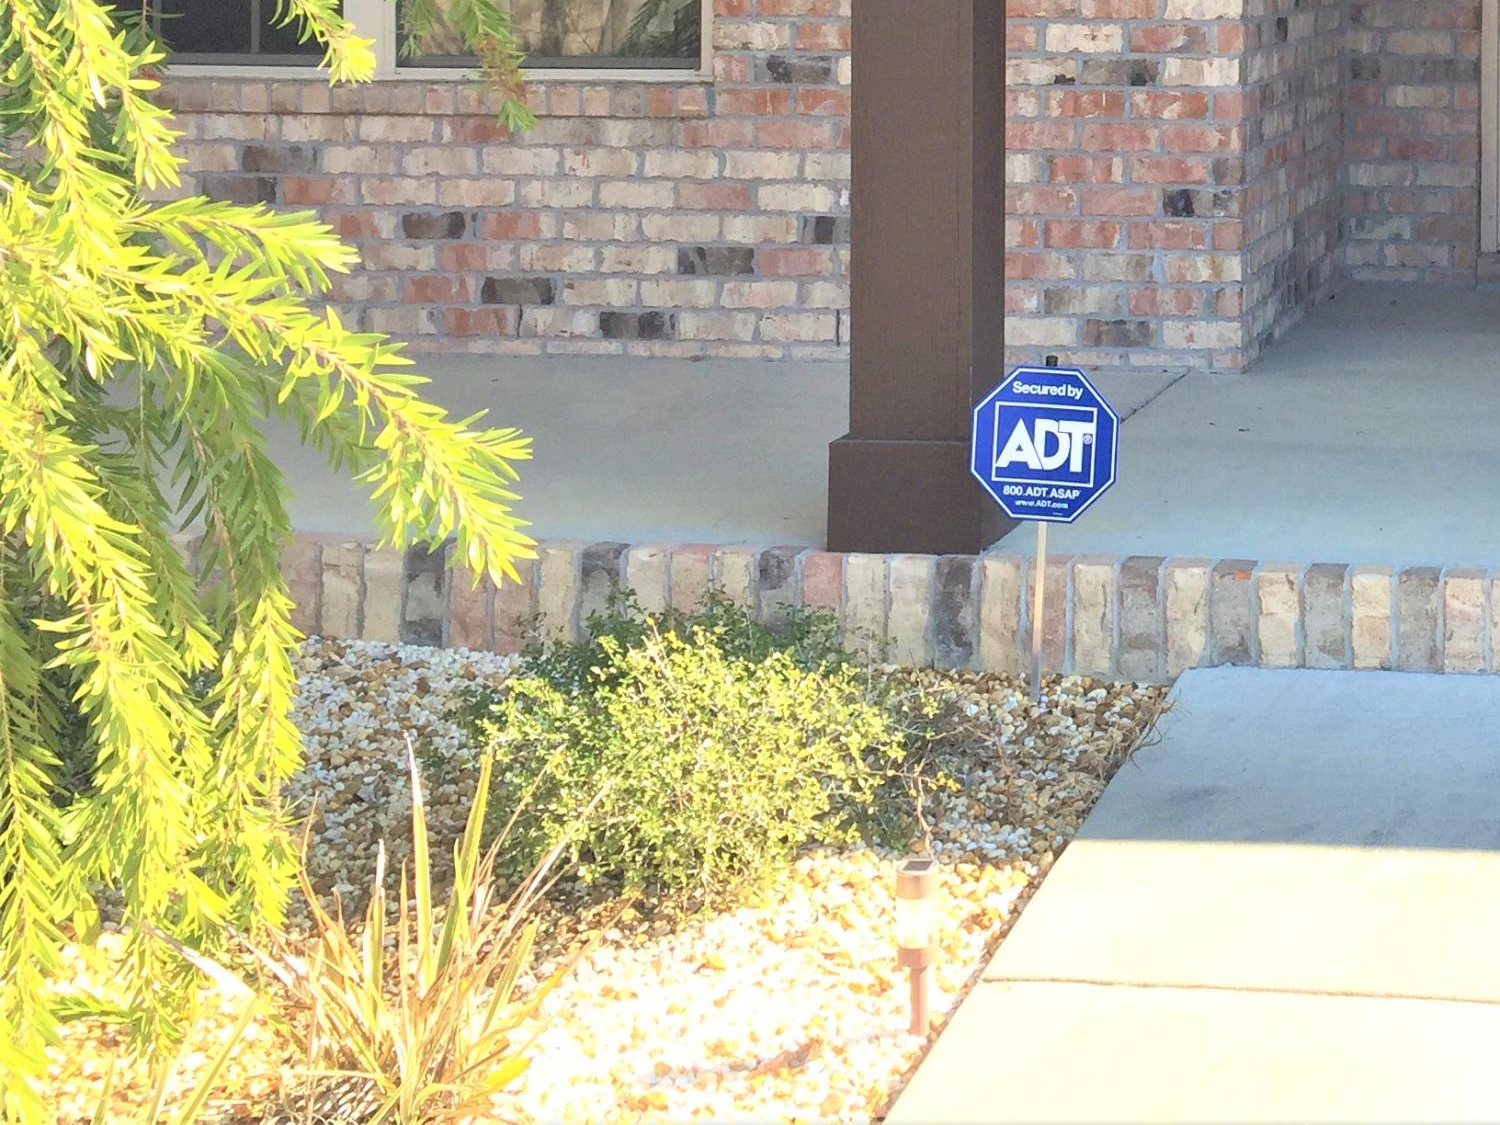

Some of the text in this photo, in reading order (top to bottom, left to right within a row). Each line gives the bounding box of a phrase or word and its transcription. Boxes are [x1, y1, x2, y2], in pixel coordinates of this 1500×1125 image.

[1012, 381, 1084, 400] Secured by
[995, 418, 1095, 473] ADT
[1003, 485, 1080, 499] 800.ADT.ASAP
[1015, 500, 1069, 509] www.ADT.com
